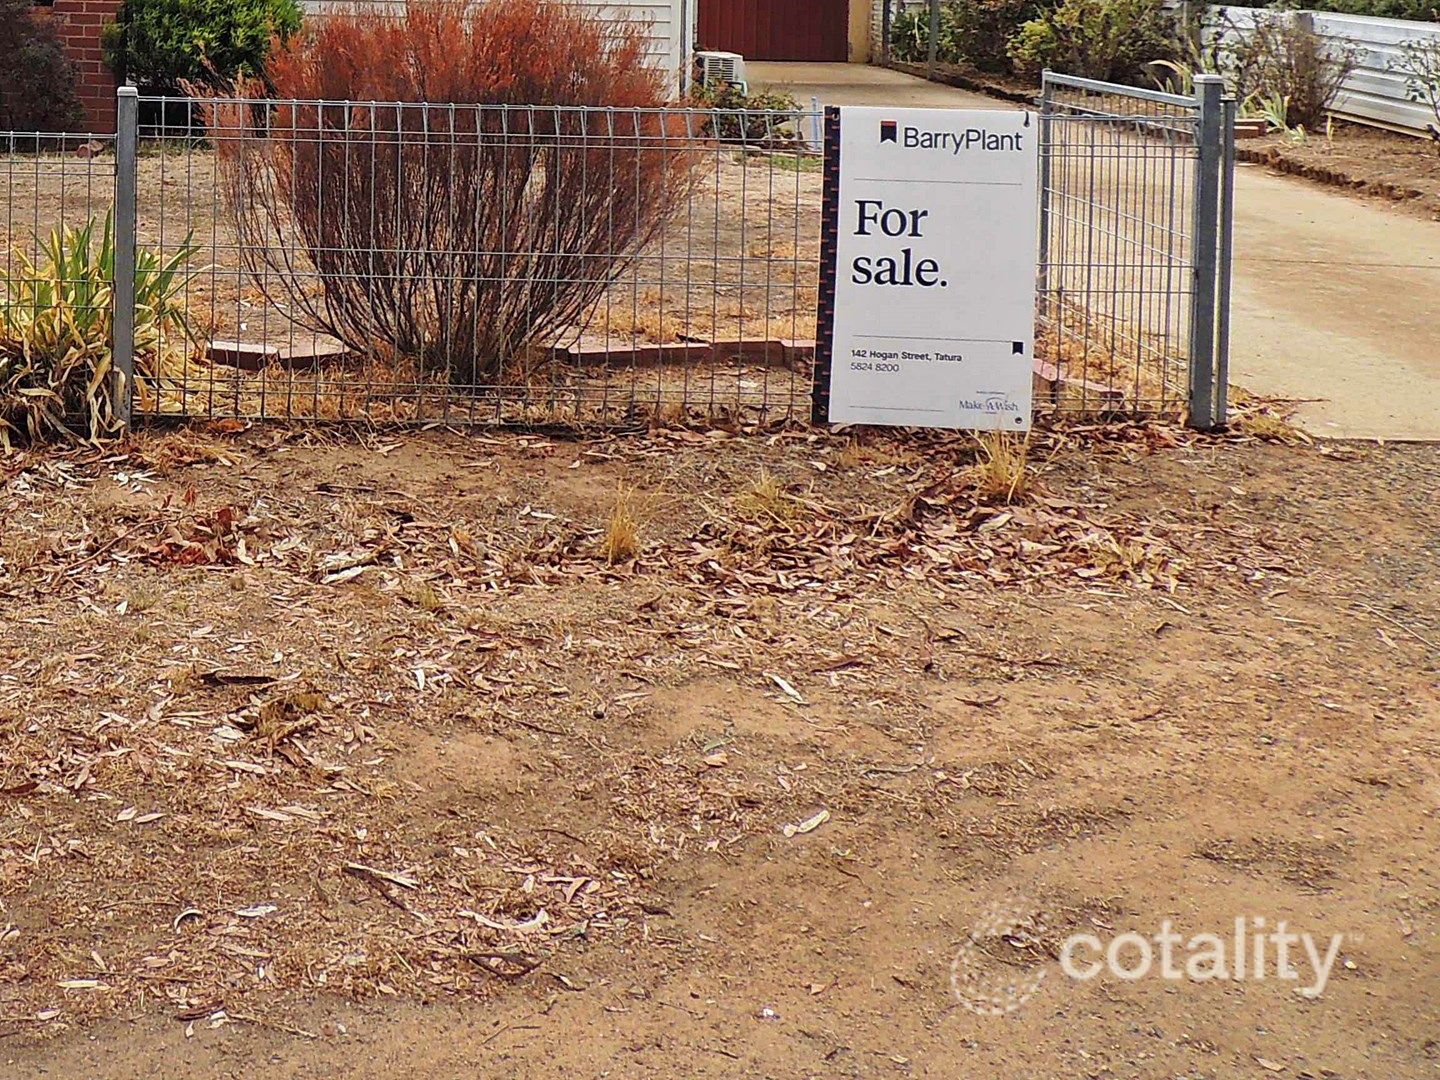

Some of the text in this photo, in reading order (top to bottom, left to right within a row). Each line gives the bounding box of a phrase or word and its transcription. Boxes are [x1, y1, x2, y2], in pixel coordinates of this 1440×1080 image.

[904, 126, 1023, 155] BarryPlant
[853, 200, 929, 237] For
[852, 248, 948, 287] sale.
[850, 362, 900, 372] 5824 8200
[851, 349, 962, 362] 142 Hogan Street, Tatura
